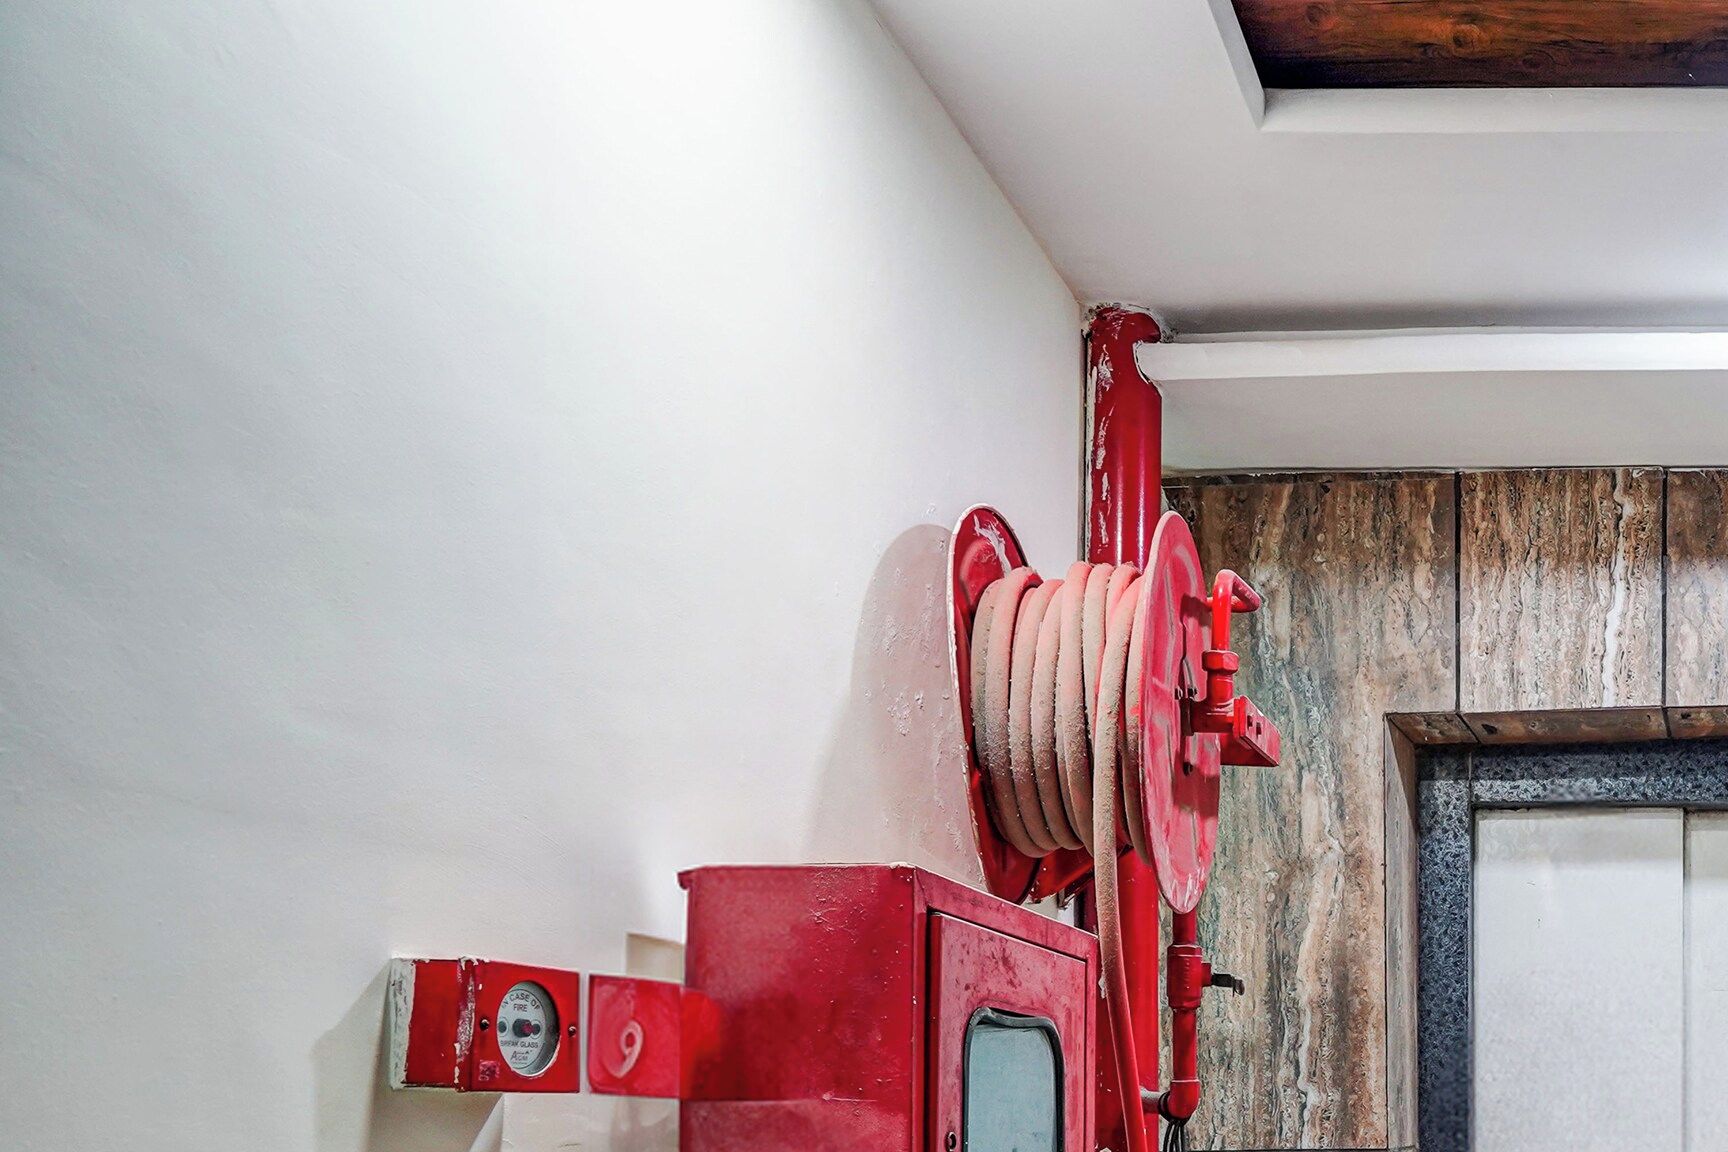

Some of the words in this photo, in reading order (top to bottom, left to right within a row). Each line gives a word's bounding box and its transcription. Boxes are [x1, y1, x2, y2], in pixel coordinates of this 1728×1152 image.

[510, 993, 530, 1003] CASE
[530, 999, 541, 1010] OF
[513, 1003, 528, 1012] FIRE
[520, 1041, 538, 1049] GLASS
